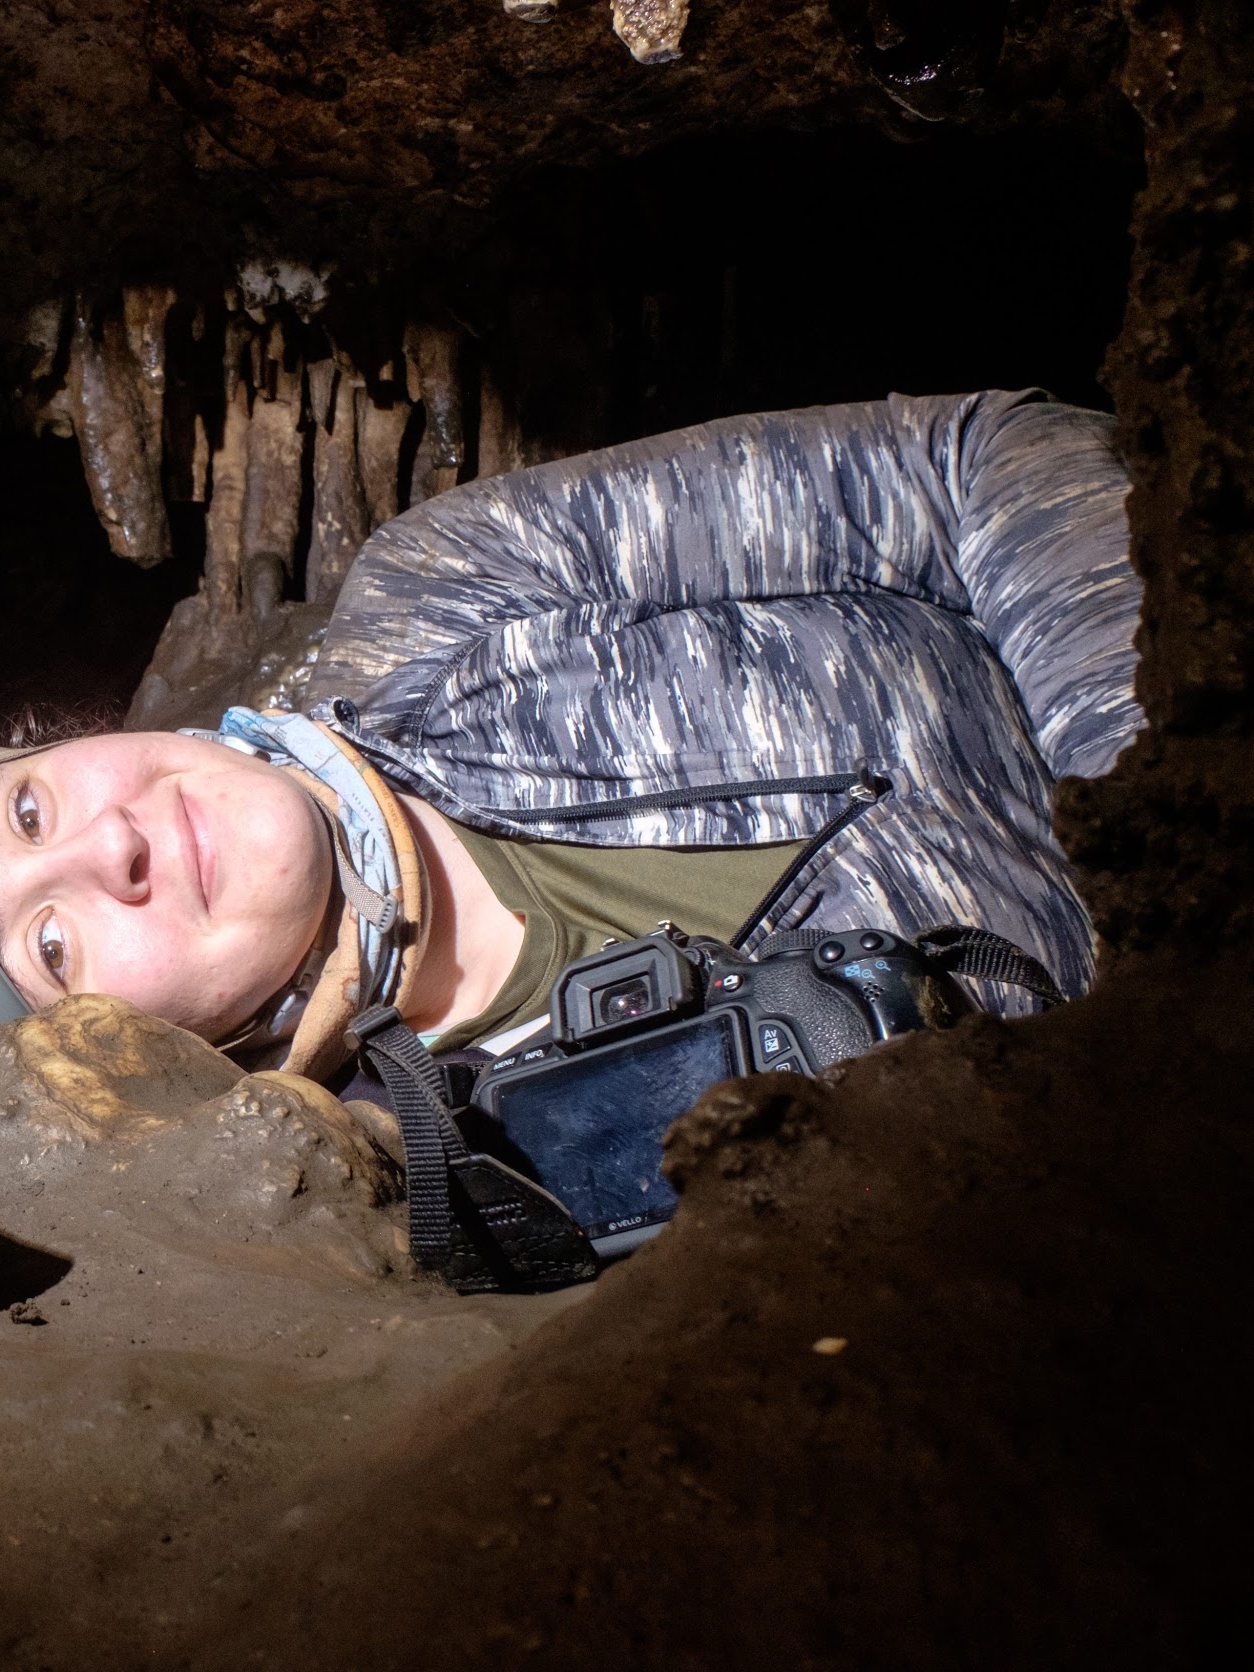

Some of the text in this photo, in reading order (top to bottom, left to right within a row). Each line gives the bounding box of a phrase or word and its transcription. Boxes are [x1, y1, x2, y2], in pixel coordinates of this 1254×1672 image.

[764, 1029, 777, 1040] Av
[493, 1057, 516, 1071] MENU
[616, 1216, 642, 1228] VELLO
